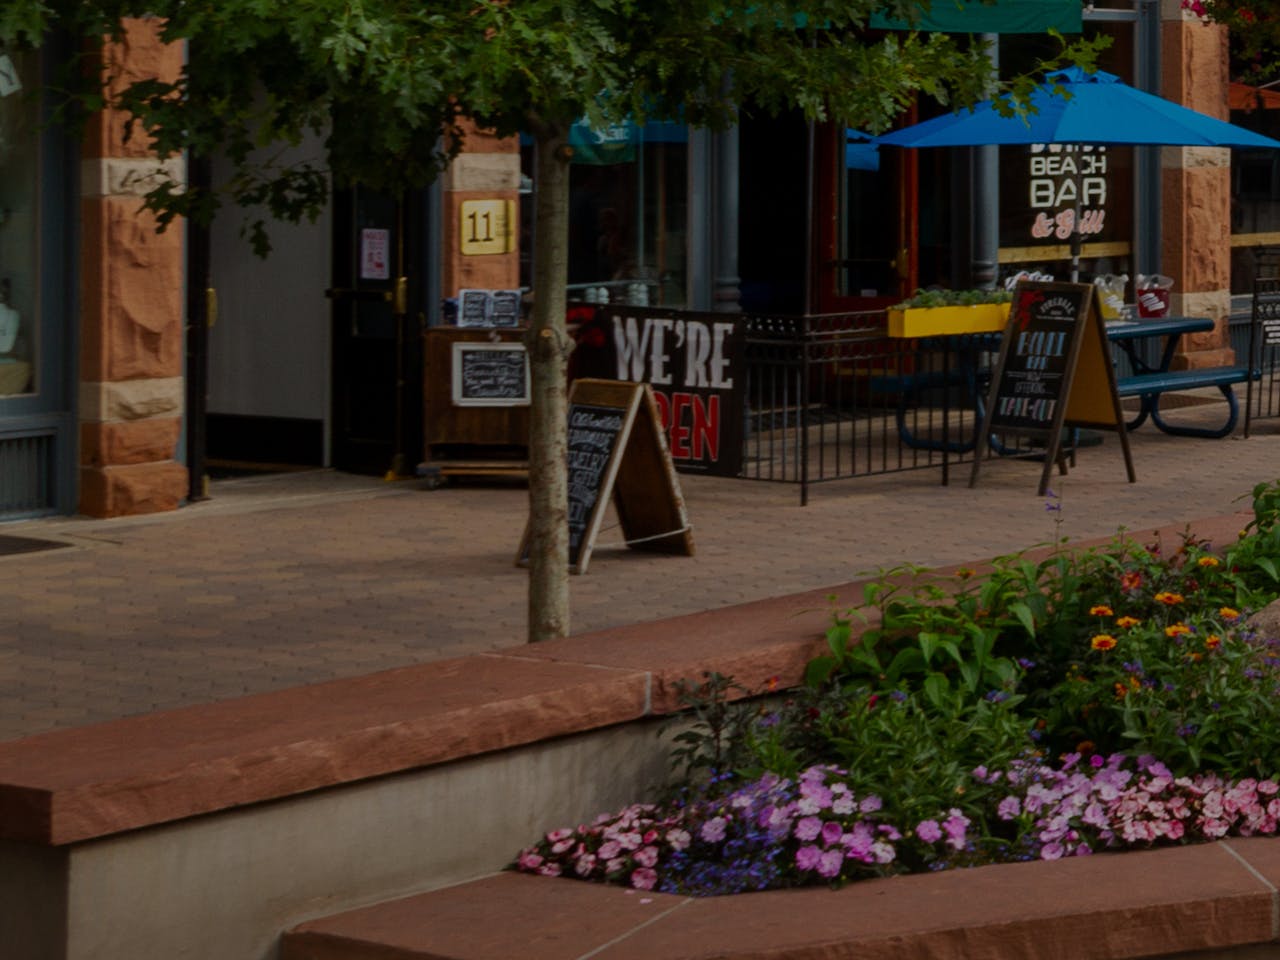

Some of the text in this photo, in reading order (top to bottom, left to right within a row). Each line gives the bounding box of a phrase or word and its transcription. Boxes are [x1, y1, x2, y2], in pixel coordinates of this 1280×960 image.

[1030, 155, 1107, 175] BEACH
[1030, 177, 1107, 208] BAR
[468, 211, 493, 242] 11
[1055, 208, 1105, 239] Gill
[612, 315, 734, 389] WE'RE
